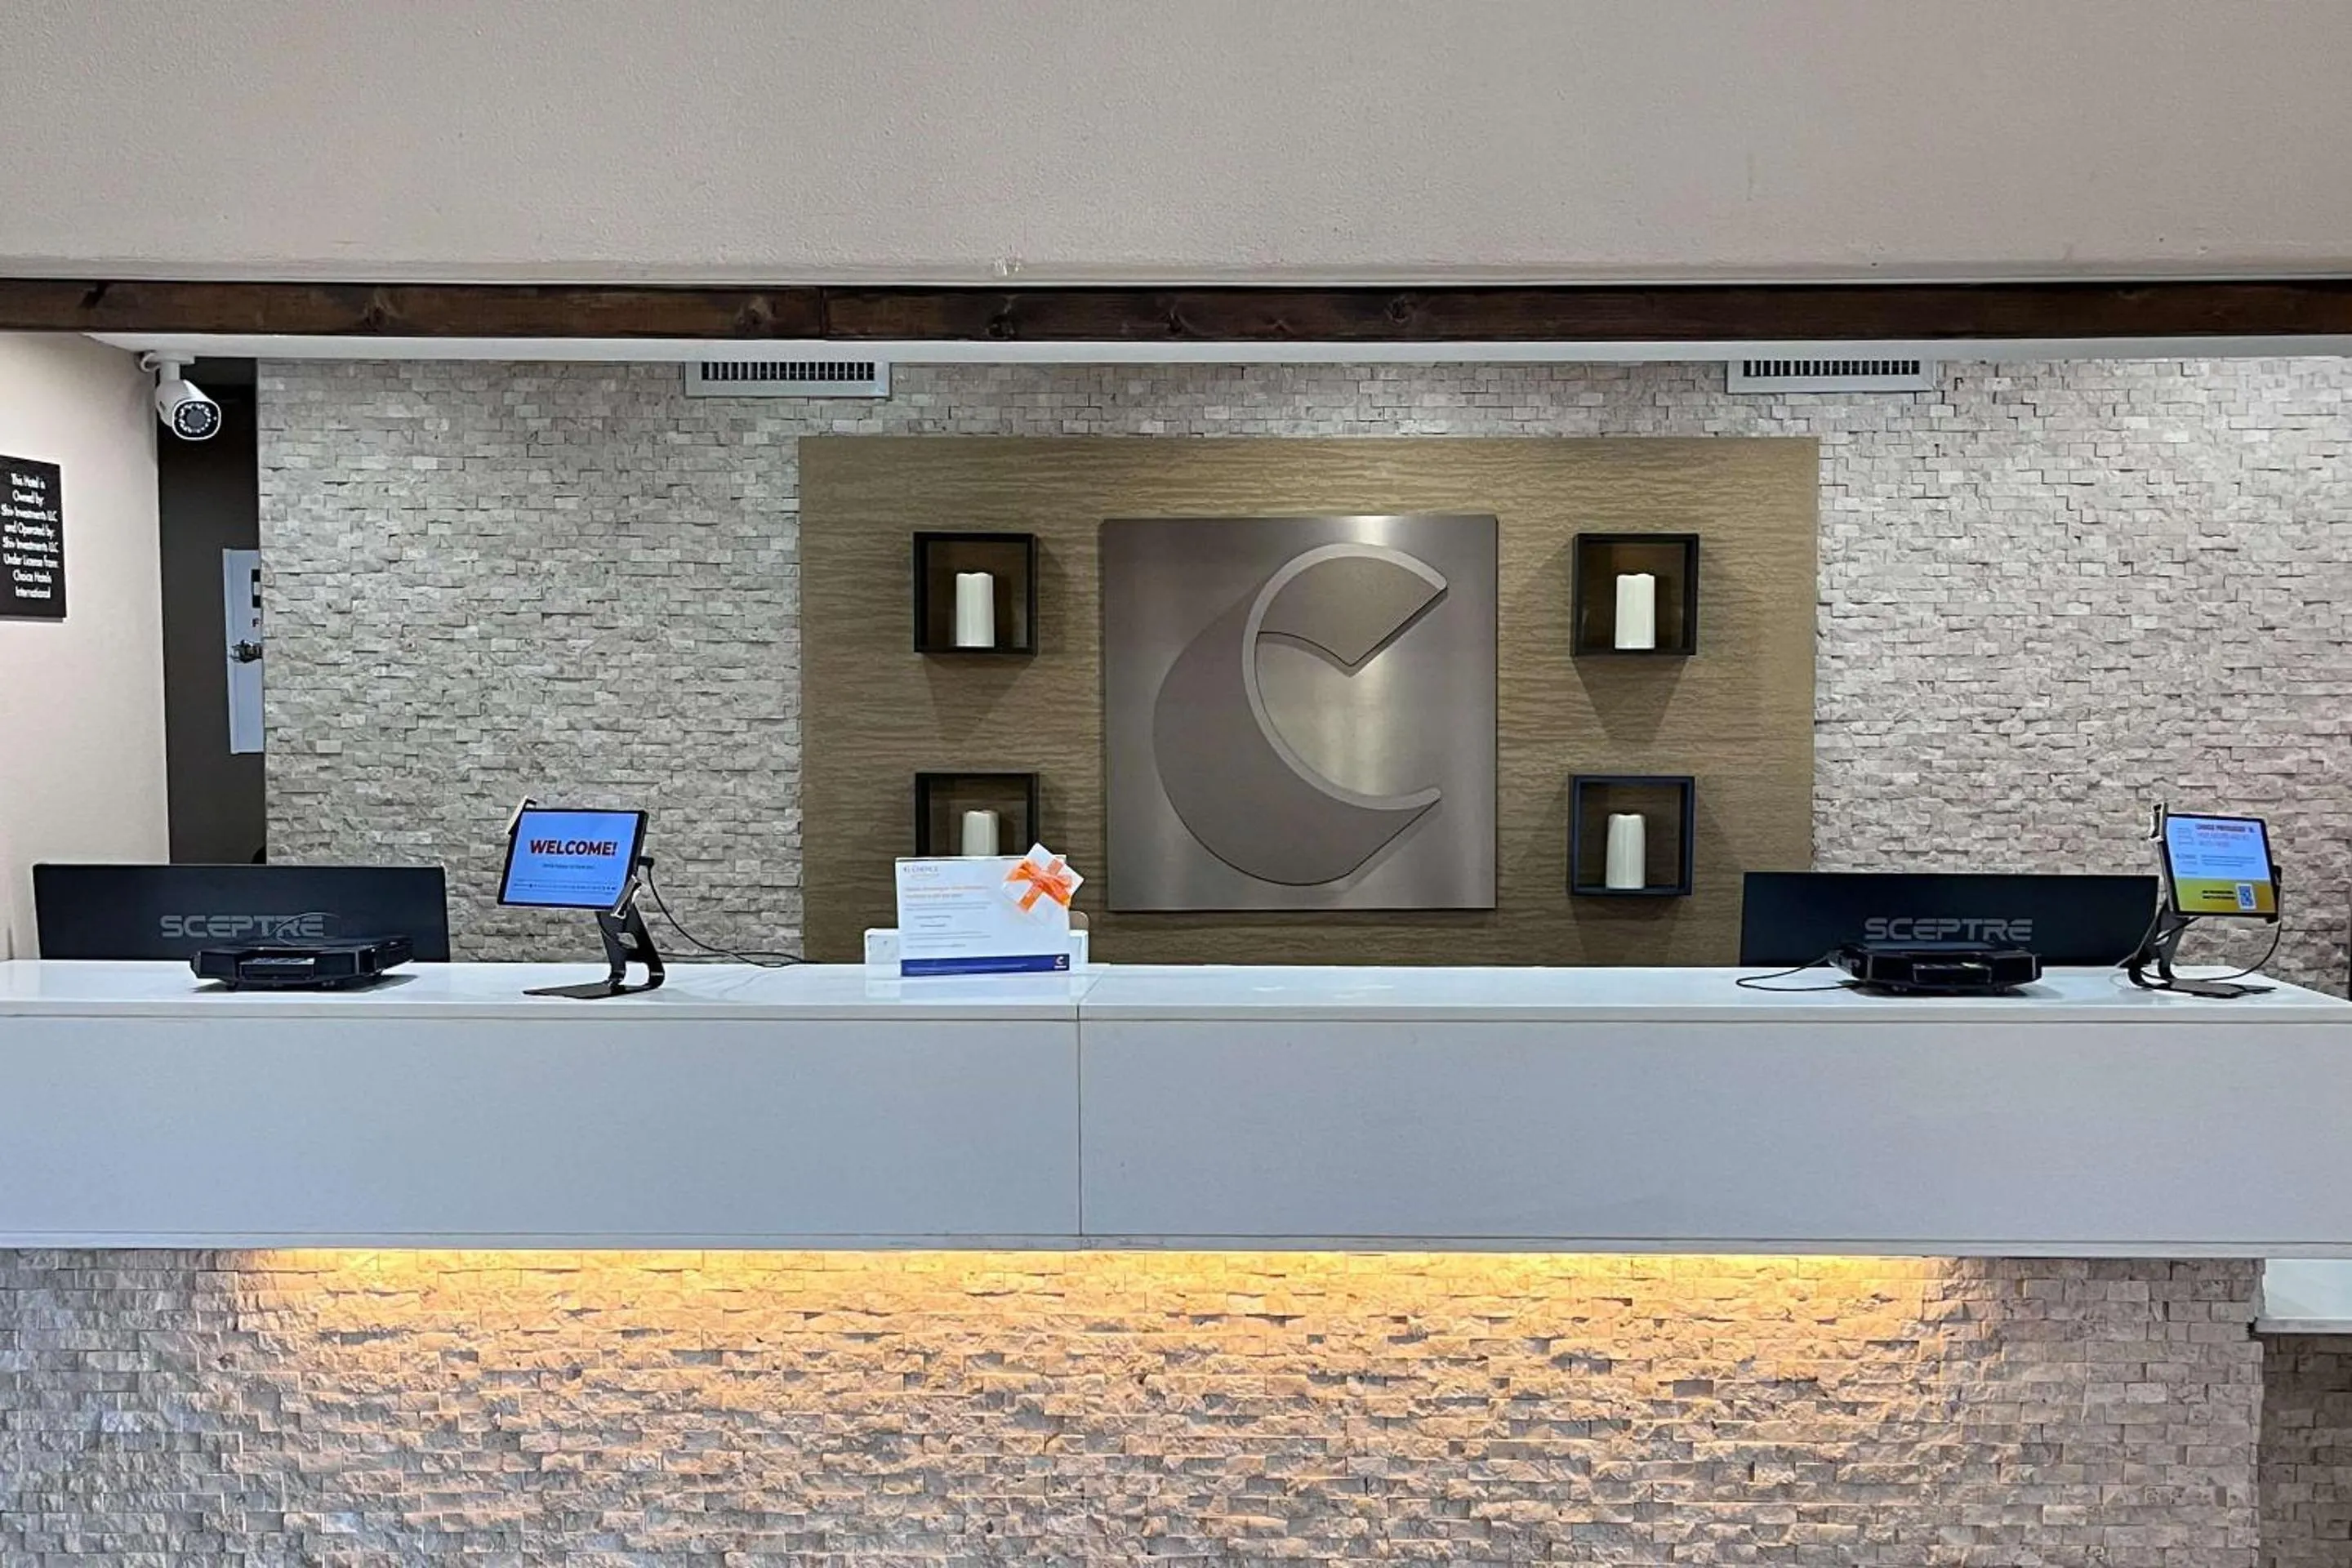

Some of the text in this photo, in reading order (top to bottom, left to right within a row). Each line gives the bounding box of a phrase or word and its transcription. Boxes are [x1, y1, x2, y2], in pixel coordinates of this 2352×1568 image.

[12, 489, 35, 504] Owned
[4, 520, 17, 533] and
[18, 522, 45, 537] Operated
[3, 553, 22, 565] Under
[23, 555, 43, 567] License
[12, 569, 52, 584] Choice Hotels
[15, 586, 51, 599] International
[530, 840, 618, 856] WELCOME!
[160, 915, 325, 938] SCEPTRE
[1864, 917, 2033, 941] SCEPTRE
